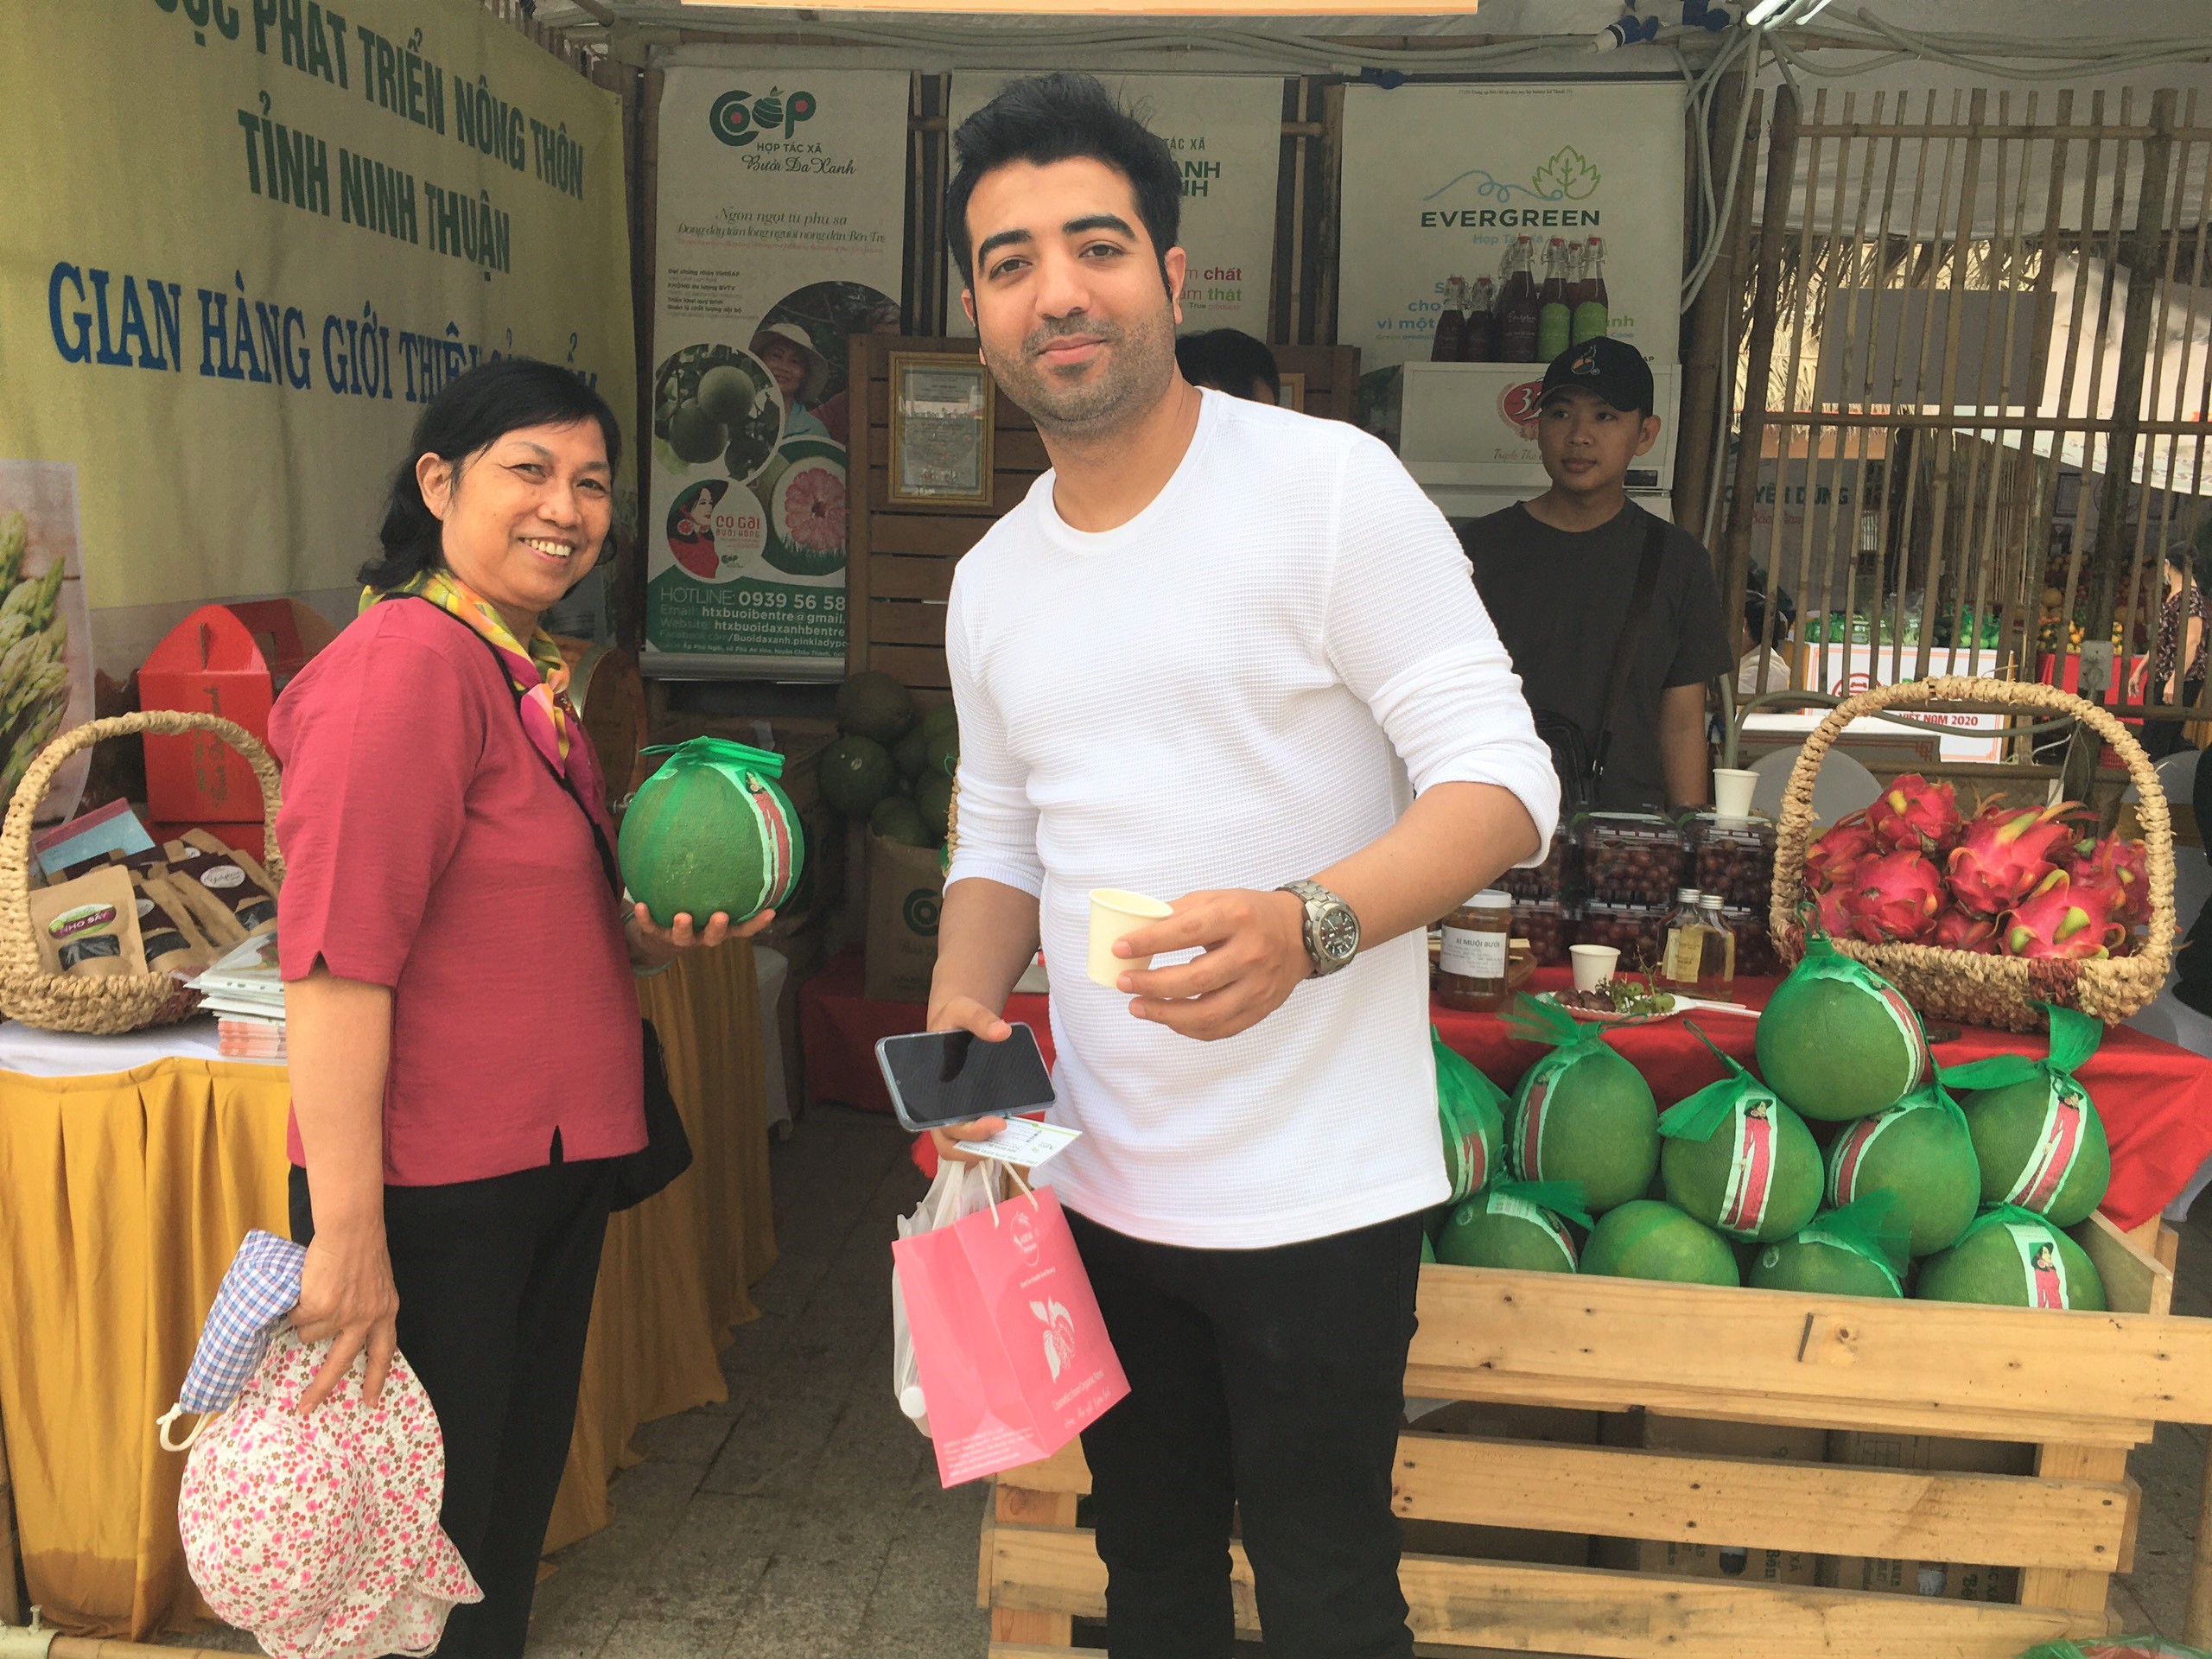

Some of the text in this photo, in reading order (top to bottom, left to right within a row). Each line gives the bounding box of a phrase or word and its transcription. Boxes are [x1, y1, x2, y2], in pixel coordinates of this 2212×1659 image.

[357, 27, 444, 136] TRIỂN
[454, 74, 526, 172] NÔNG
[529, 118, 584, 200] THÔN
[757, 142, 822, 155] HỢP TÁC XÃ
[1191, 137, 1205, 150] XÃ
[811, 157, 856, 175] Xanh
[238, 91, 511, 282] TỈNH NINH THUẬN
[1421, 209, 1599, 228] EVERGREEN
[1204, 266, 1242, 281] chất
[1408, 300, 1441, 312] cho
[48, 261, 181, 373] GIAN
[198, 269, 311, 391] HÀNG
[321, 299, 392, 399] GIỚI
[1399, 315, 1435, 332] một
[660, 588, 845, 611] HOTLINE: 0939 56 58
[1923, 715, 1948, 726] NAM
[1951, 715, 1978, 726] 2020
